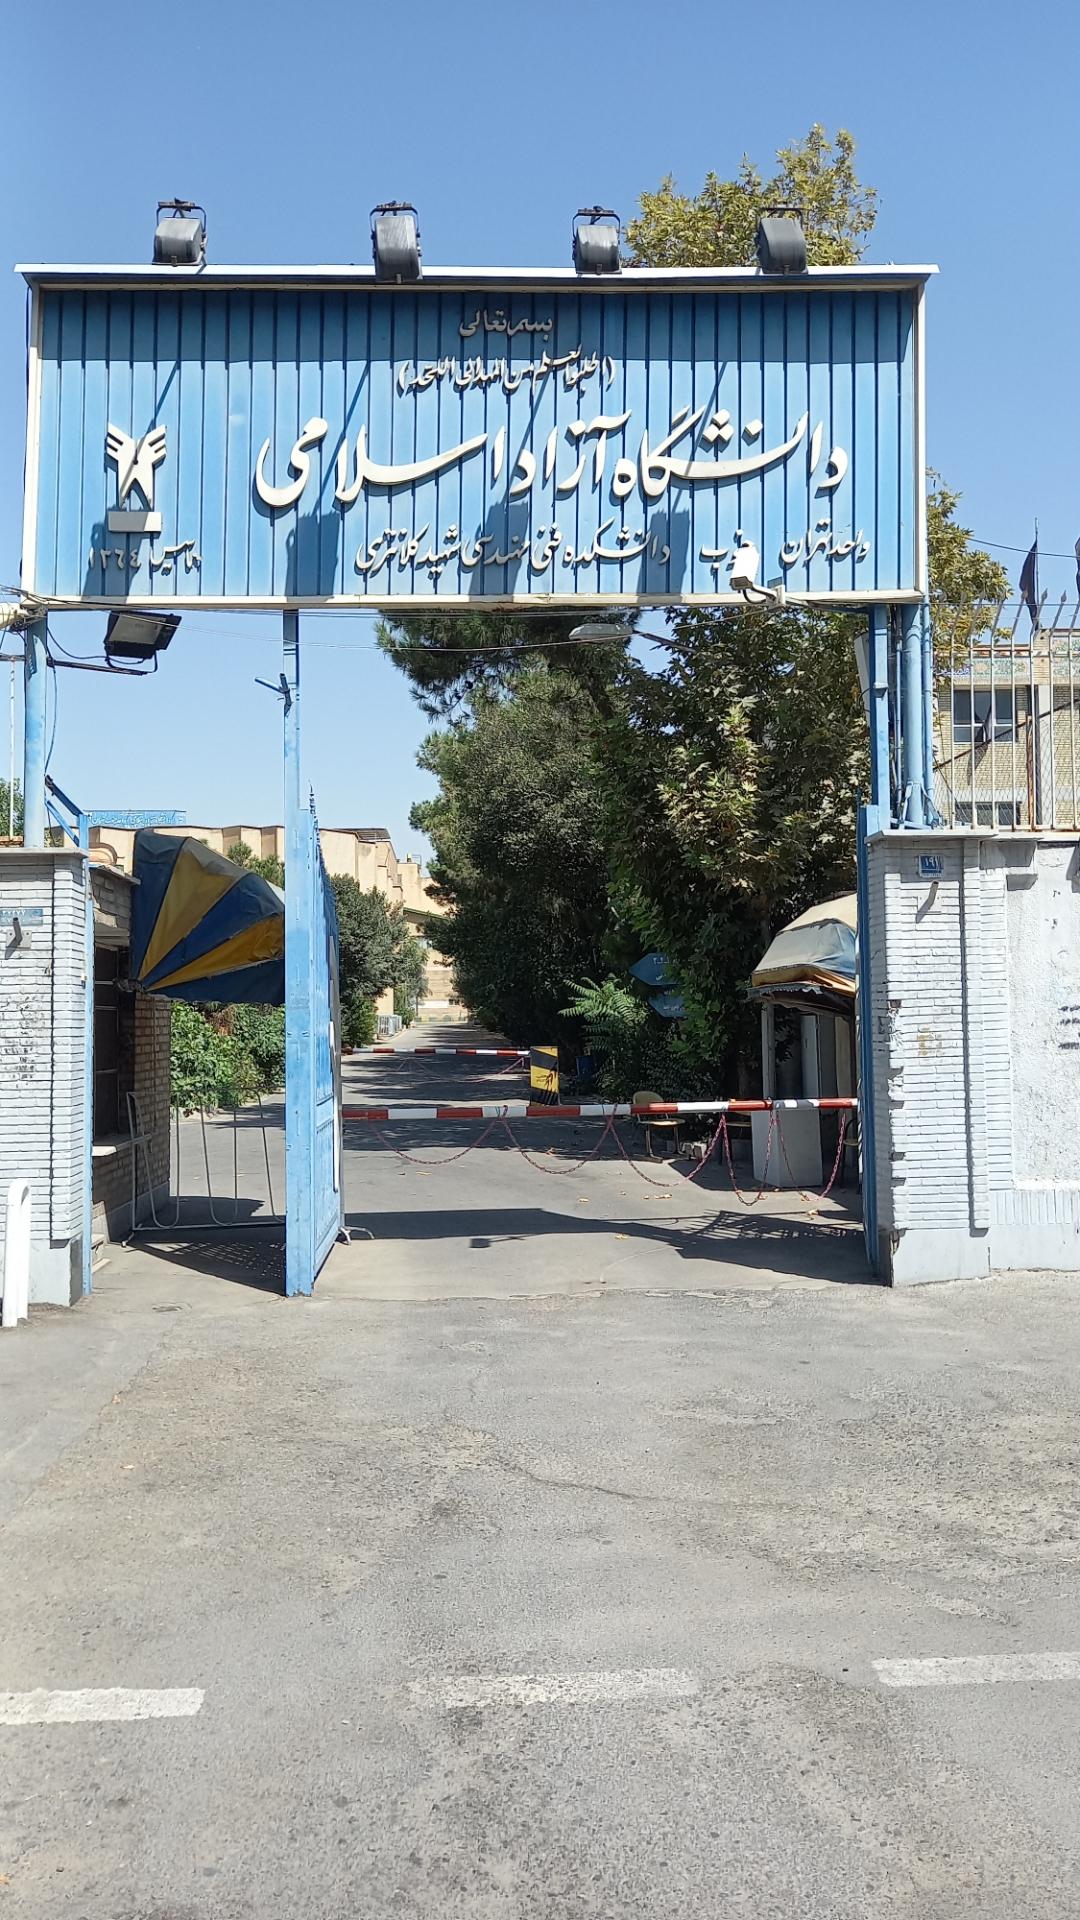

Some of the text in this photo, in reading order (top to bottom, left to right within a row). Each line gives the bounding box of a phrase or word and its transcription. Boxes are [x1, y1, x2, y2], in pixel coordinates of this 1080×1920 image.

[459, 309, 508, 337] تعالی
[503, 362, 535, 390] من
[254, 405, 849, 507] دانشگاه آزاد اسلامی
[355, 522, 431, 572] کلانتری
[415, 524, 462, 571] شهید
[461, 534, 531, 567] مهندسی
[530, 522, 563, 570] فنی
[563, 516, 671, 564] دانشکده
[780, 517, 832, 564] تهران
[827, 528, 871, 558] واحد
